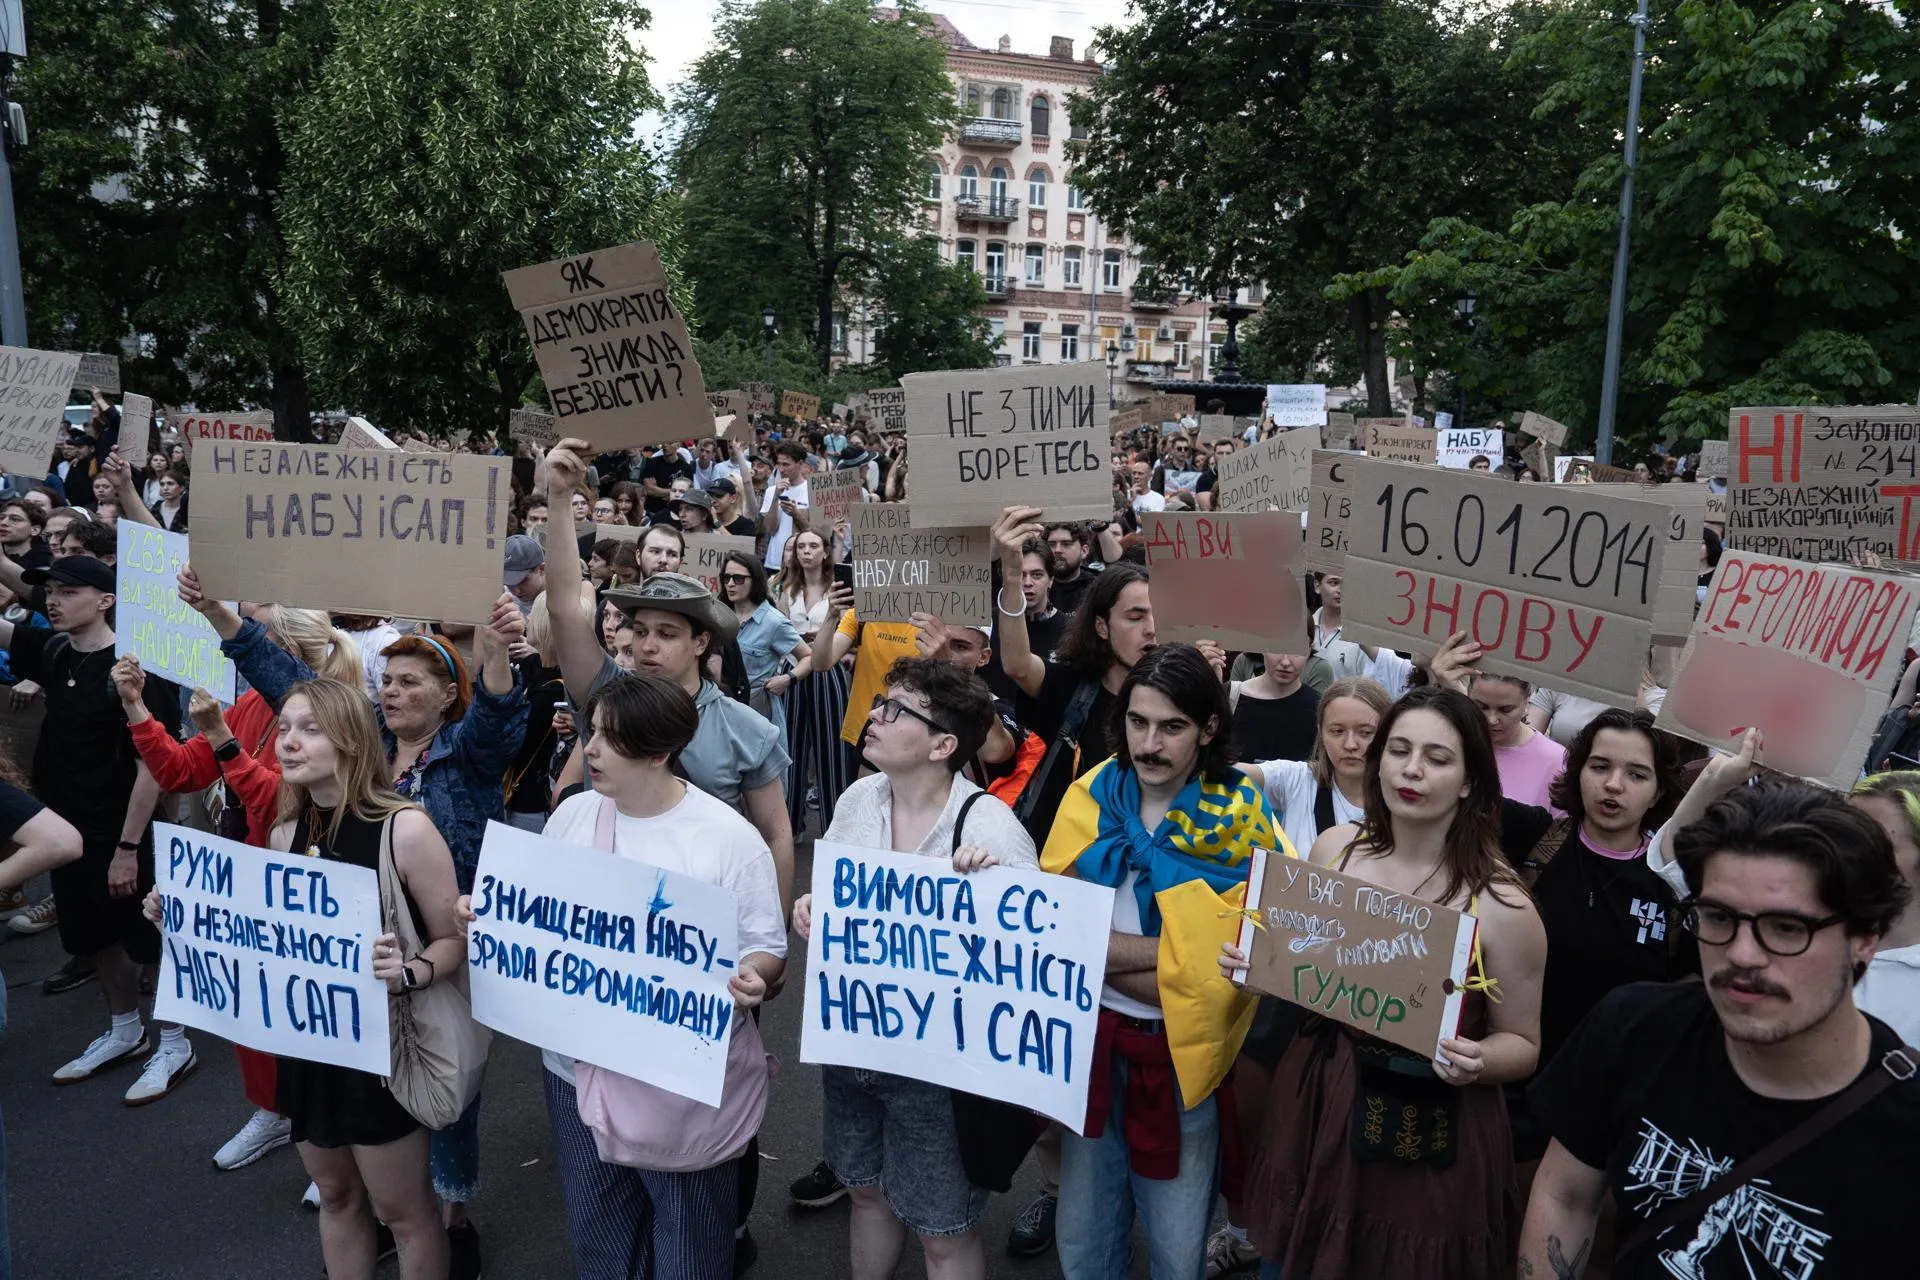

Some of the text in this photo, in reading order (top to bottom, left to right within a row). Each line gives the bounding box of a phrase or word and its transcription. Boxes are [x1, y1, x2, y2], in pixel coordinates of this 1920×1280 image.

[560, 257, 605, 293] ЯК
[532, 289, 674, 348] ДЕМОКРАТІЯ
[570, 331, 685, 378] ЗНИКЛА
[947, 391, 987, 438] НЕ
[1000, 390, 1016, 433] З
[1022, 385, 1095, 432] ТИМИ
[1447, 431, 1493, 450] НАБУ
[958, 440, 1100, 483] БОРЕТЕСЬ
[1221, 440, 1288, 482] ШЛЯХ НА
[1739, 414, 1804, 484] НІ
[246, 493, 363, 540] НАБУ
[1732, 478, 1880, 507] НЕЗАЛЕЖНІЙ
[127, 528, 165, 575] 263
[853, 532, 970, 558] НЕЗАЛЕЖНОСТІ
[854, 559, 896, 588] НАБУ
[939, 562, 974, 585] ШЛЯХ
[1376, 484, 1655, 604] 16.01.2014
[858, 590, 987, 621] ДИКТАТУРИ!
[1386, 569, 1605, 673] ЗНОВУ
[1704, 559, 1912, 680] РЕФОРМАТОРИ
[133, 615, 172, 671] НАШ
[170, 837, 340, 918] РУКИ ГЕТЬ
[833, 857, 1060, 934] ВИМОГА ЄС:
[1279, 865, 1432, 931] У ВАС ПОГАНО
[194, 902, 362, 974] НЕЗАЛЕЖНОСТІ
[474, 875, 636, 954] ЗНИЩЕННЯ
[1267, 906, 1346, 953] ВИХОДИТЬ
[168, 937, 241, 1019] НАБУ
[286, 974, 361, 1043] САП
[469, 930, 732, 1042] ЗРАДА ЄВРОМАЙДАНУ
[822, 911, 1093, 1012] НЕЗАЛЕЖНІСТЬ
[1293, 964, 1407, 1031] ГУМОР
[818, 971, 936, 1041] НАБУ
[987, 1001, 1072, 1084] САП
